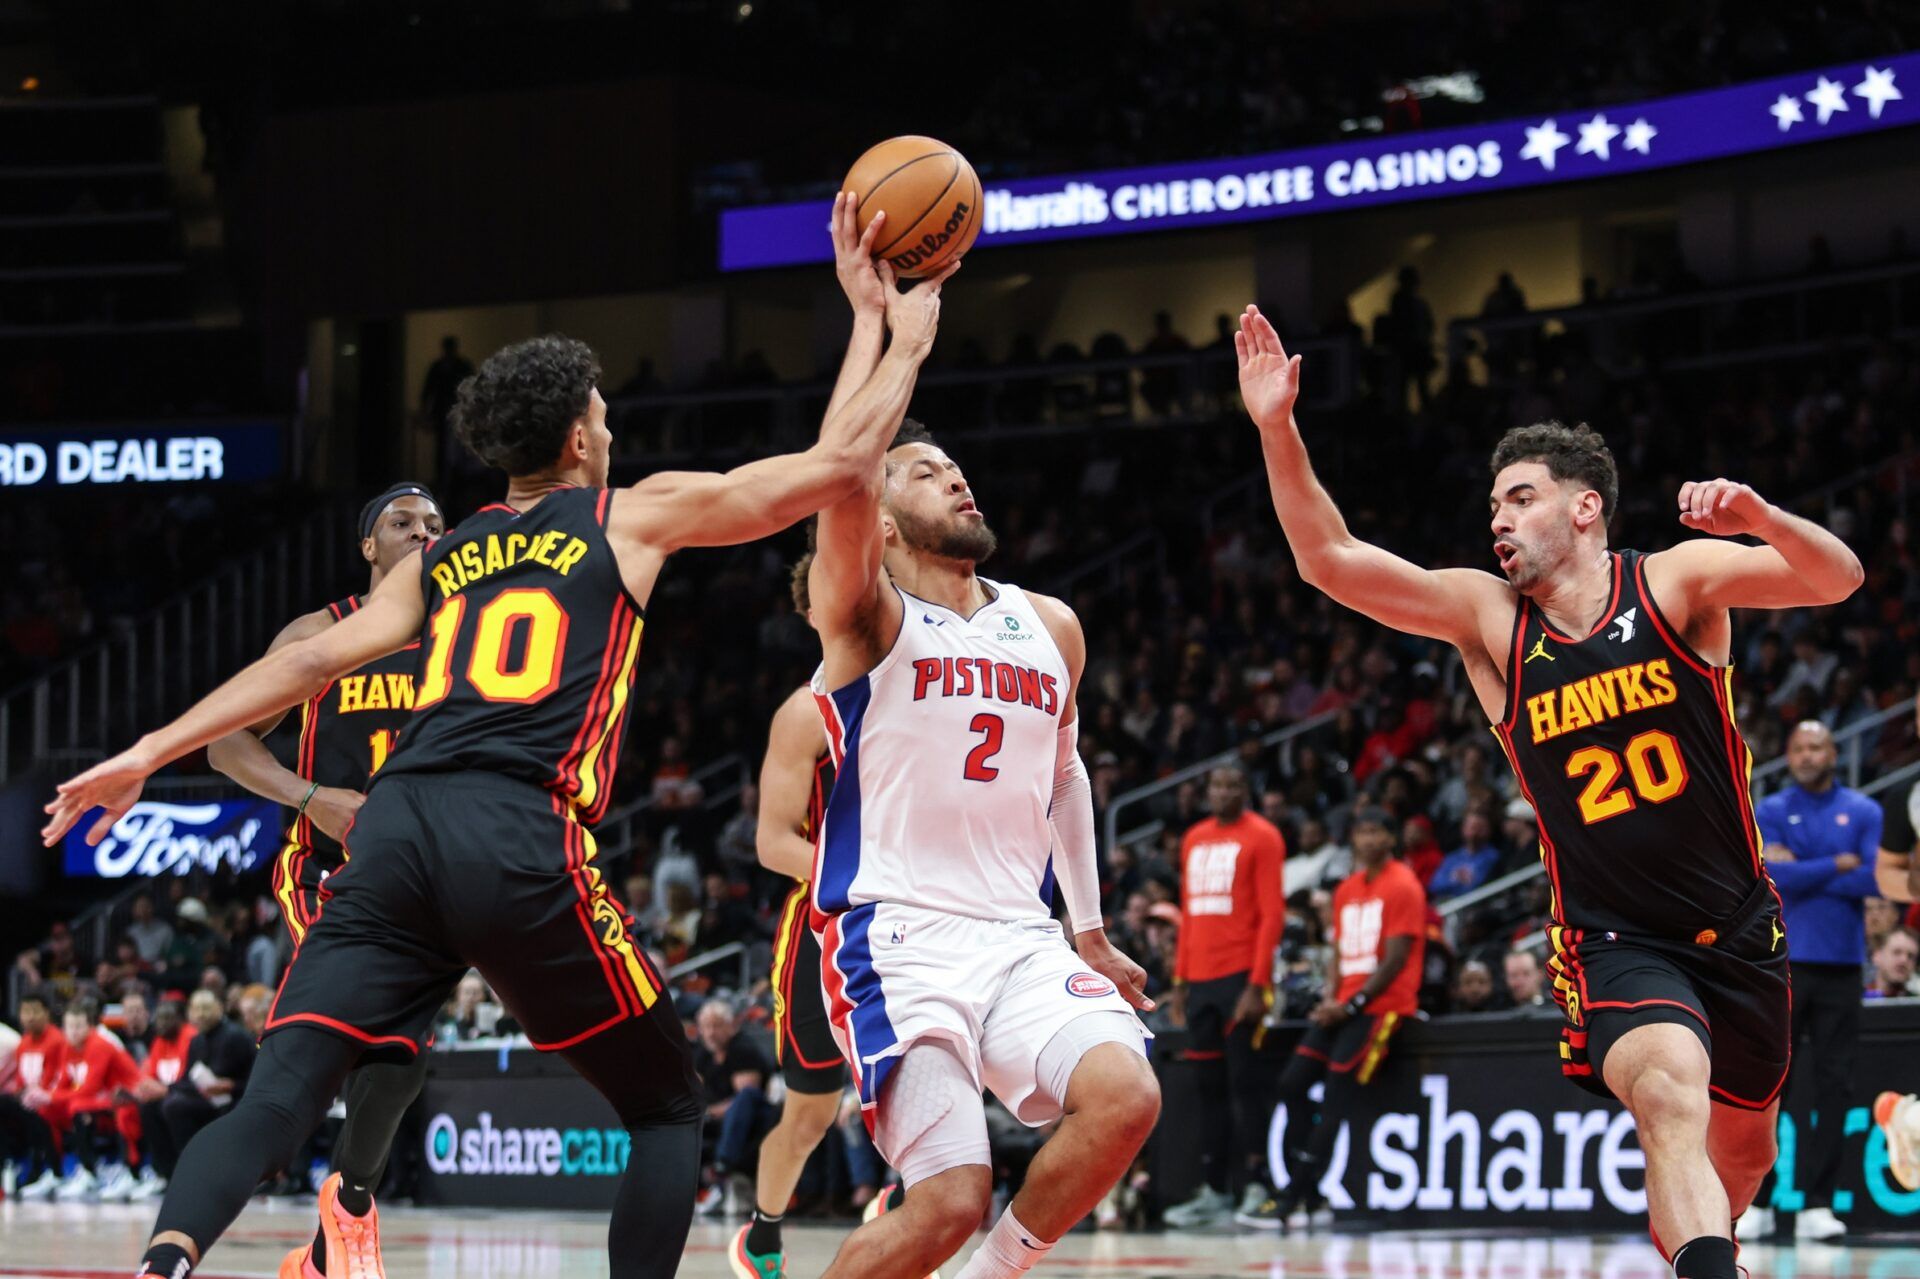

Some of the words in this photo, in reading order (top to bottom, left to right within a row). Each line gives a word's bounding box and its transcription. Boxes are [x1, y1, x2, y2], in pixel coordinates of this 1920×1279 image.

[1111, 166, 1314, 221] CHEROKEE
[1324, 140, 1502, 197] CASINOS
[892, 202, 970, 269] Wilson
[57, 436, 224, 484] DEALER
[413, 587, 570, 711] 10
[338, 673, 416, 714] HAW
[912, 657, 1058, 716] PISTONS
[1527, 657, 1678, 745] HAWKS
[369, 728, 401, 778] 1
[963, 713, 1005, 782] 2
[1564, 728, 1690, 825] 20
